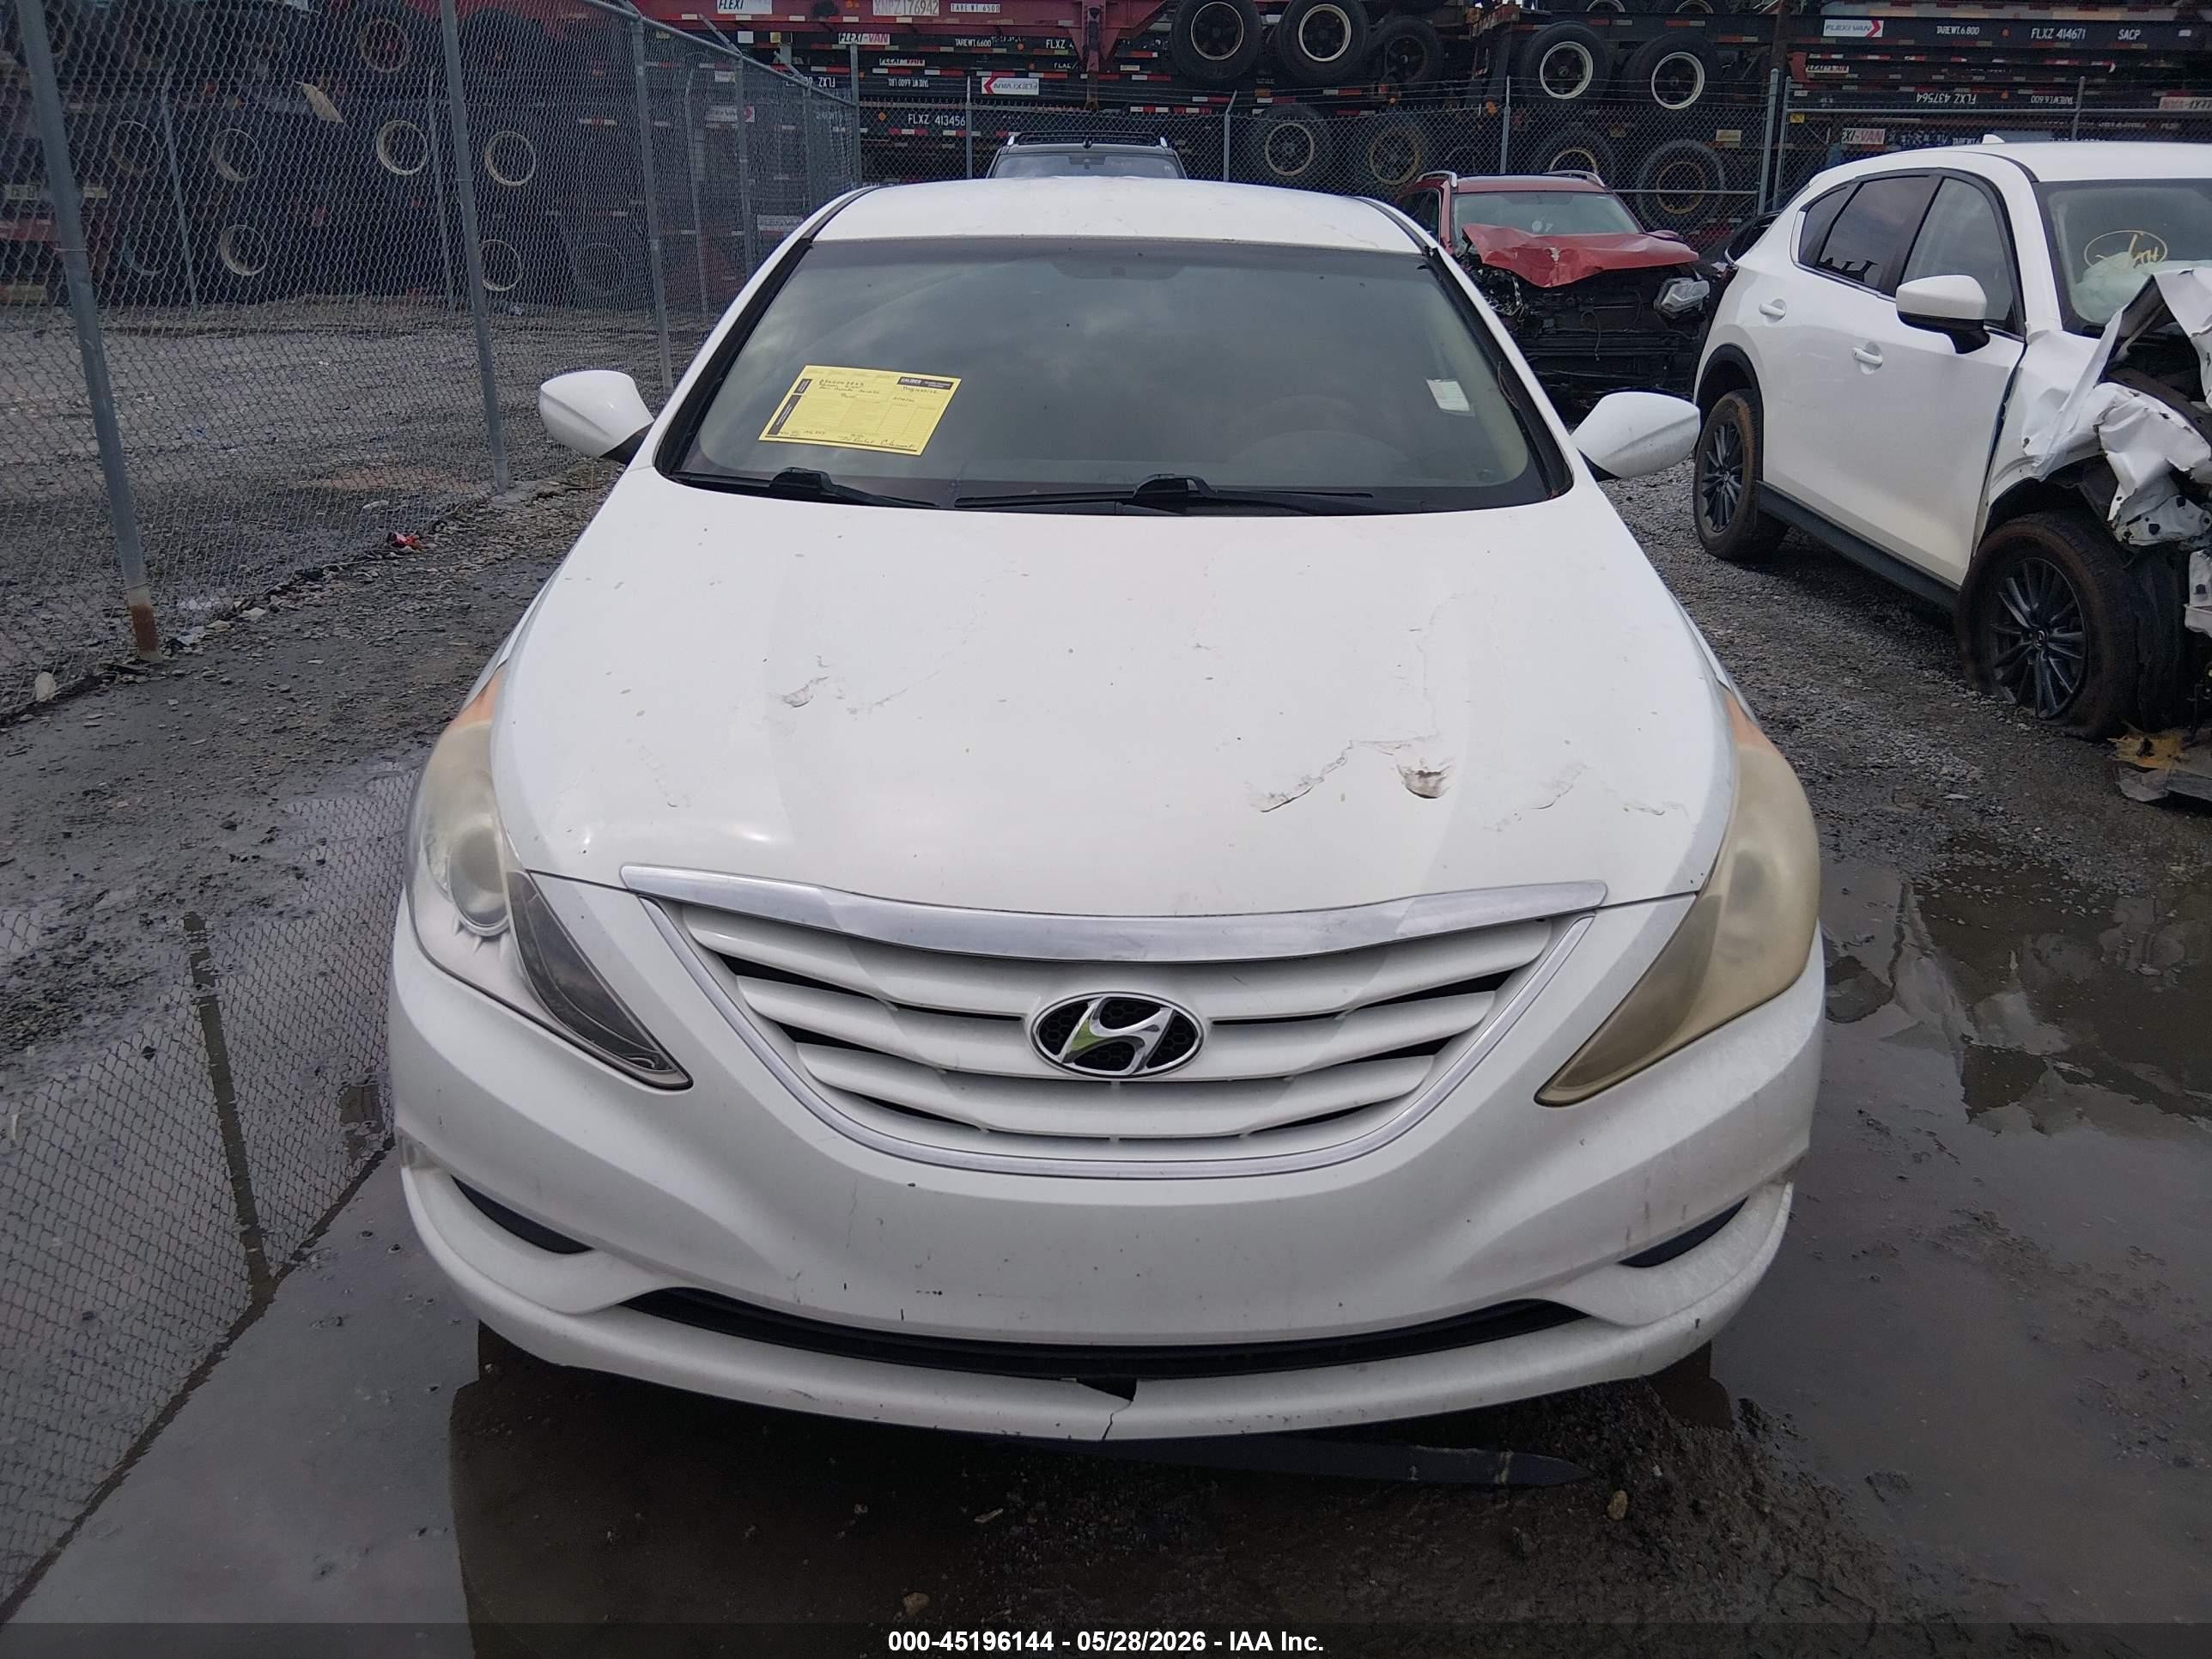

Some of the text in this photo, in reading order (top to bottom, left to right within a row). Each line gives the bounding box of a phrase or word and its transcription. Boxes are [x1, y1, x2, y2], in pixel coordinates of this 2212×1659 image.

[2031, 27, 2086, 40] FLXZ 414671
[2118, 29, 2141, 40] SACP
[1046, 40, 1065, 49] FLXZ
[1916, 92, 1977, 105] FLXZ 437564
[908, 113, 966, 126] FLXZ 413456
